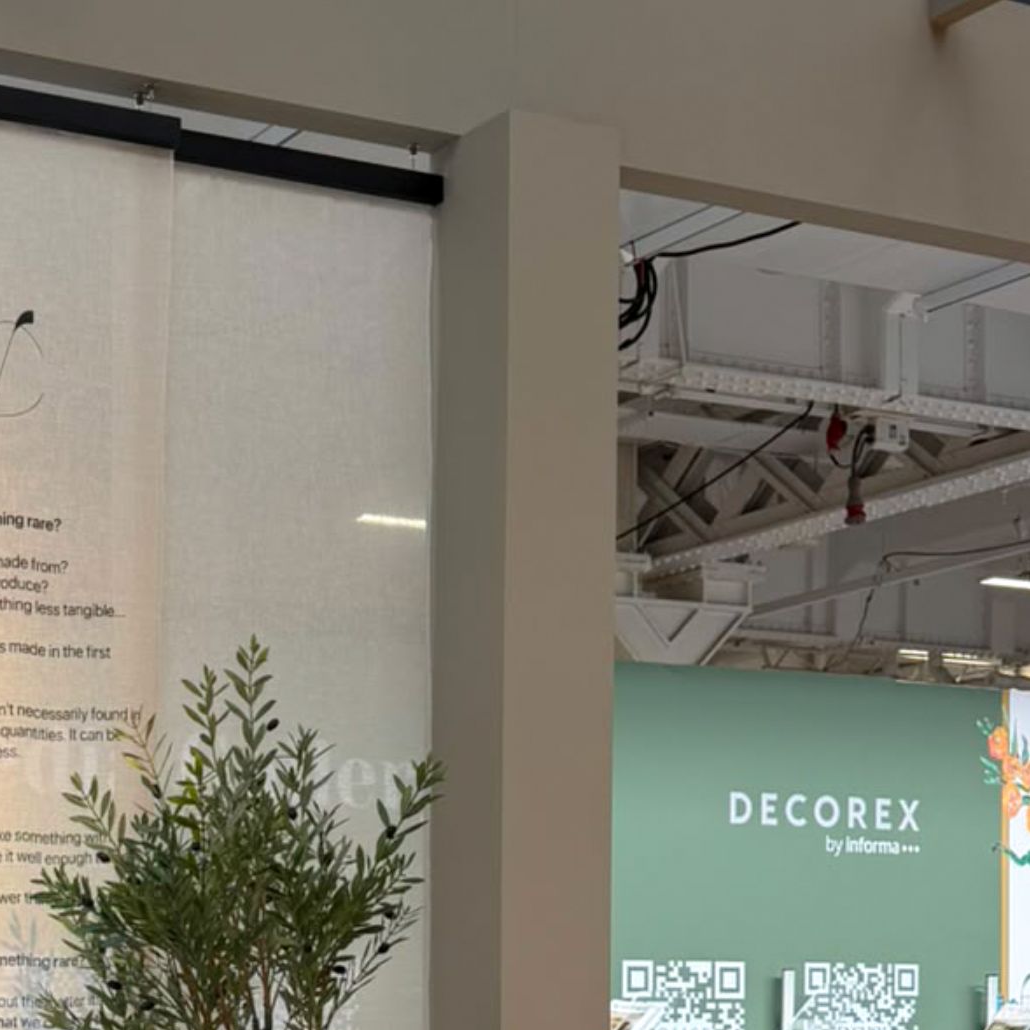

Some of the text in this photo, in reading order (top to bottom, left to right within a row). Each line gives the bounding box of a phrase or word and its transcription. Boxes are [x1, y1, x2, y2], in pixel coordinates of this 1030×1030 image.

[27, 518, 62, 532] rare?
[31, 559, 68, 574] from?
[35, 600, 60, 617] less
[9, 640, 46, 656] made
[49, 644, 60, 658] in
[63, 644, 84, 659] the
[87, 646, 111, 660] first
[18, 705, 88, 723] necessarily
[91, 708, 128, 721] found
[0, 726, 67, 743] quantities.
[70, 728, 78, 741] It
[80, 729, 103, 741] can
[106, 728, 120, 741] b
[729, 791, 920, 832] DECOREX
[14, 830, 81, 847] something
[825, 834, 900, 857] by informa
[5, 850, 14, 863] it
[17, 850, 41, 865] well
[45, 852, 93, 870] enough
